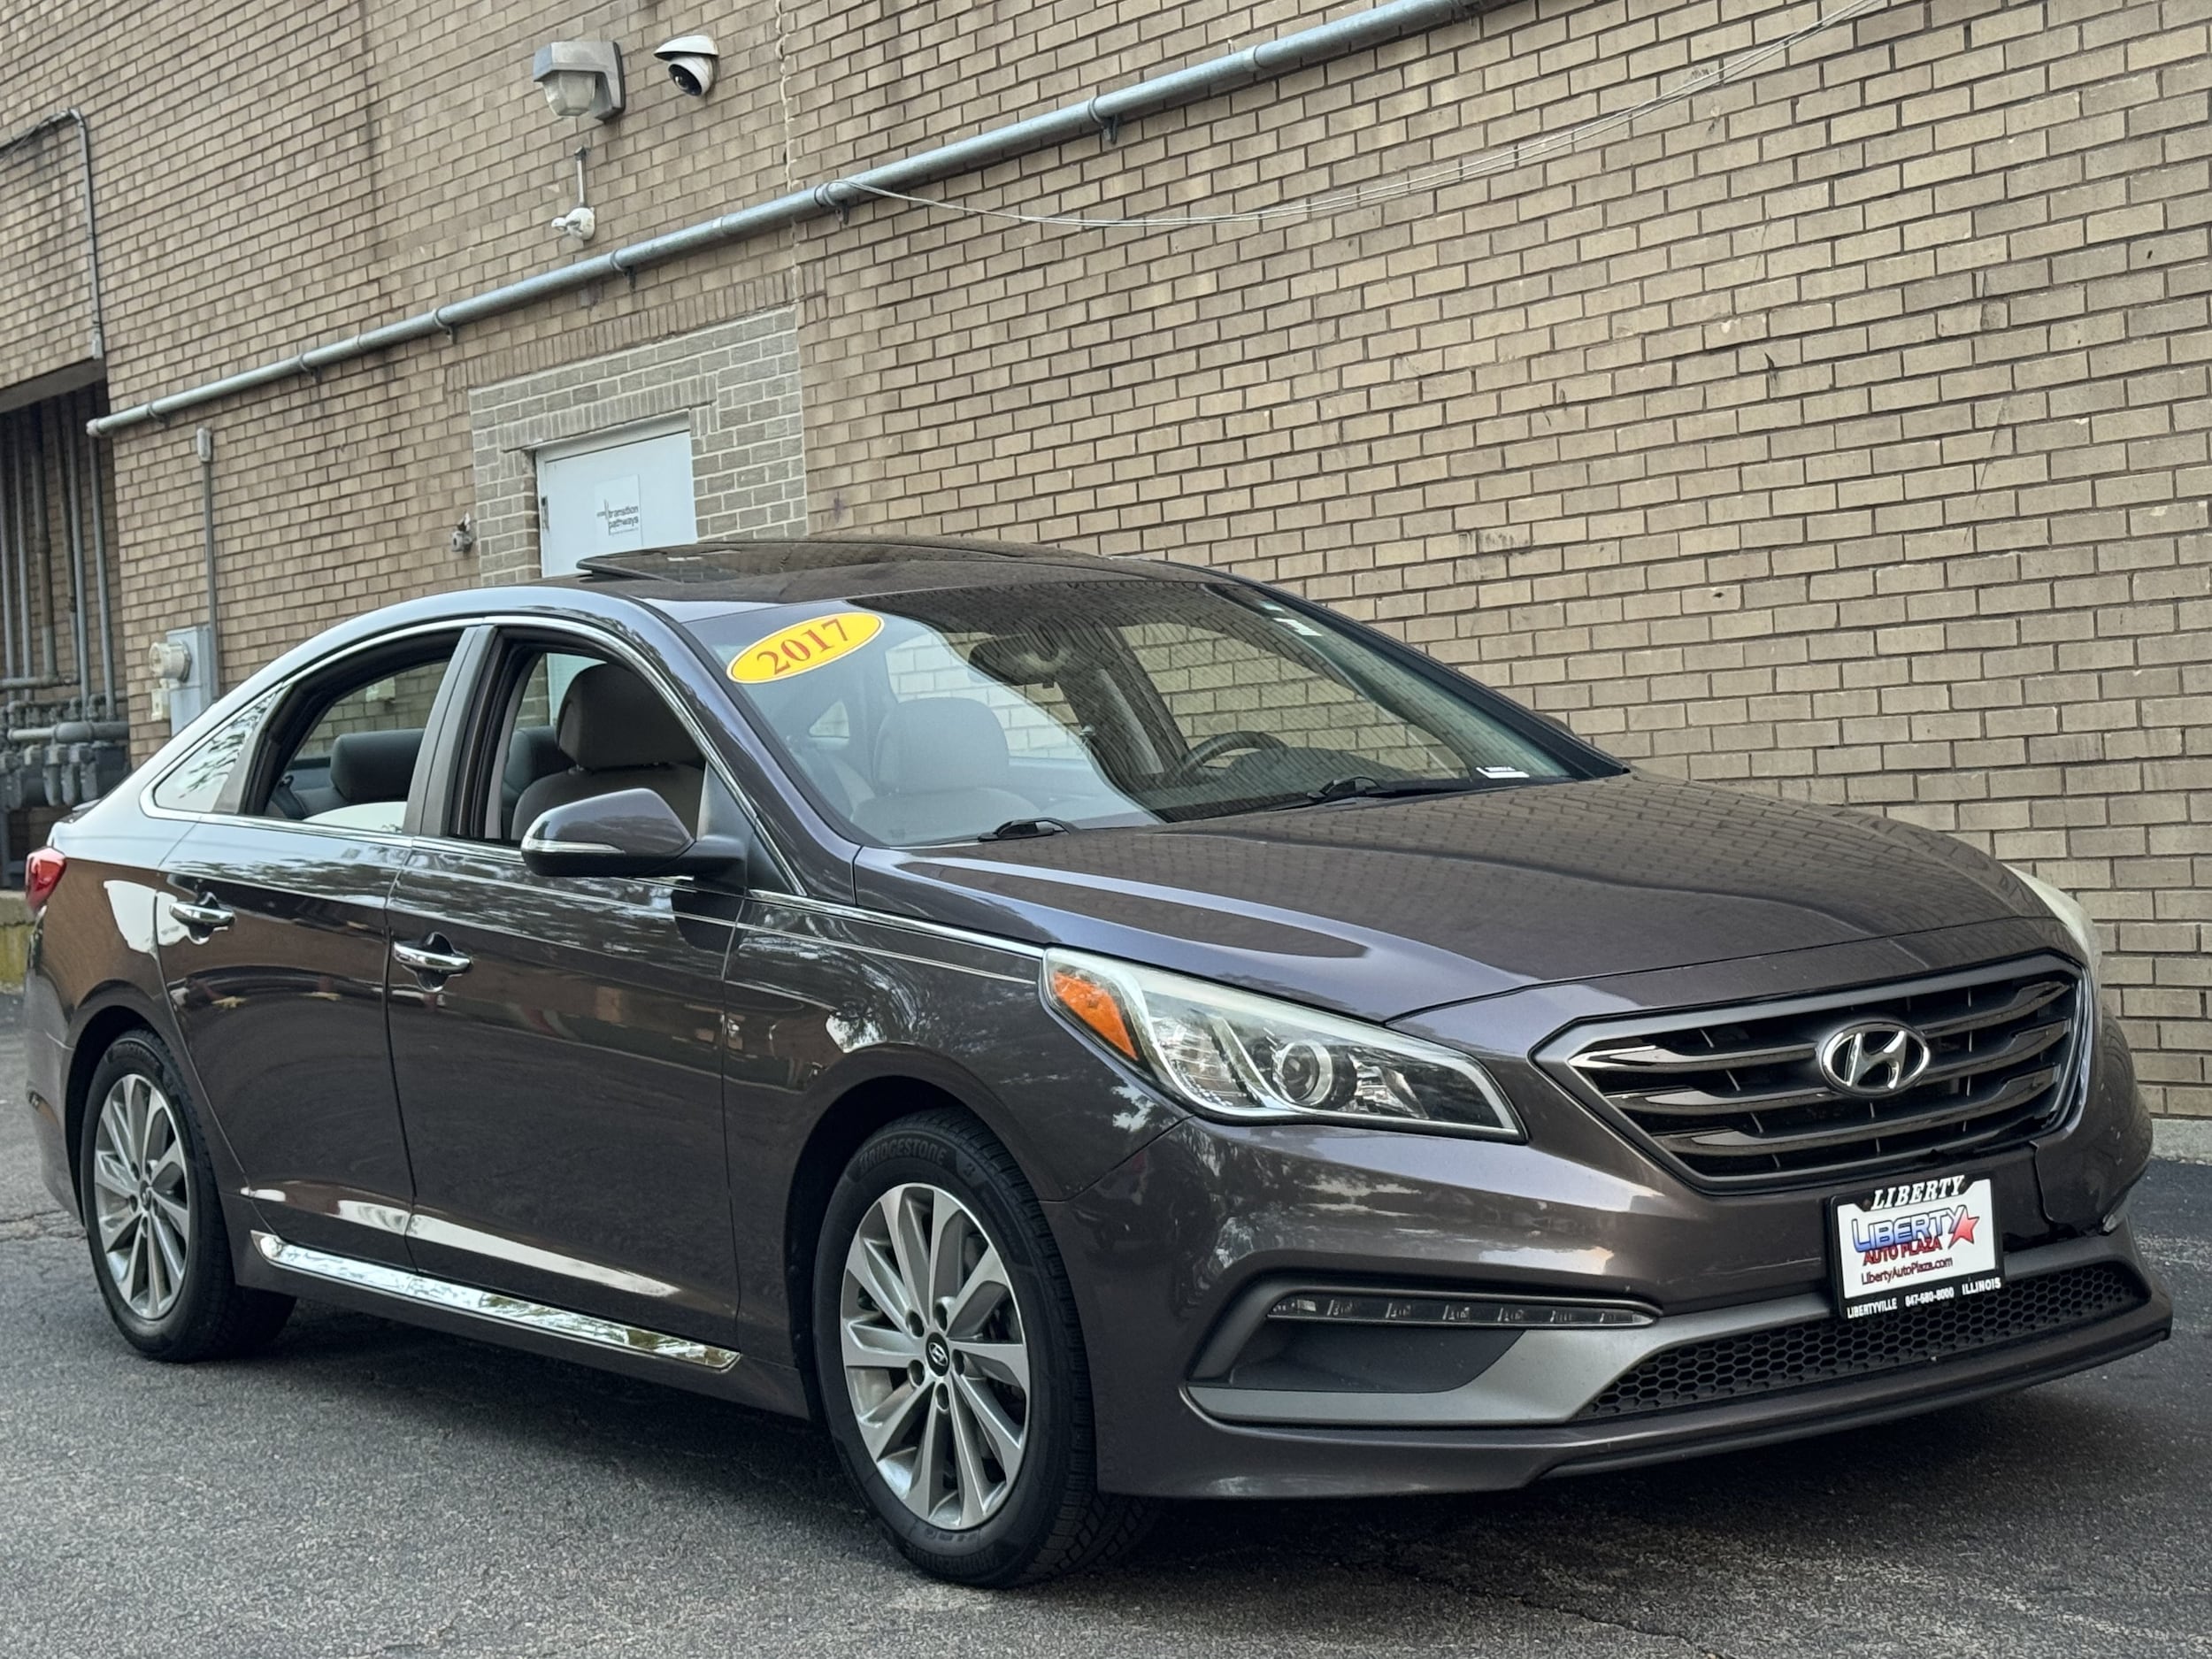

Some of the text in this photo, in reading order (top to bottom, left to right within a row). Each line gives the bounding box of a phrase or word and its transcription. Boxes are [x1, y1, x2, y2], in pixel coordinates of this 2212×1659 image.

[757, 618, 848, 675] 2017
[1870, 1175, 1964, 1210] LIBERTY
[1851, 1204, 1967, 1253] LIBERTY
[1863, 1236, 1942, 1266] AUTO PLAZA
[1861, 1257, 1953, 1286] LibertyAutoPlaza.com
[1847, 1298, 1898, 1319] LIBERTYVILLE
[1962, 1277, 2001, 1296] ILLINOIS
